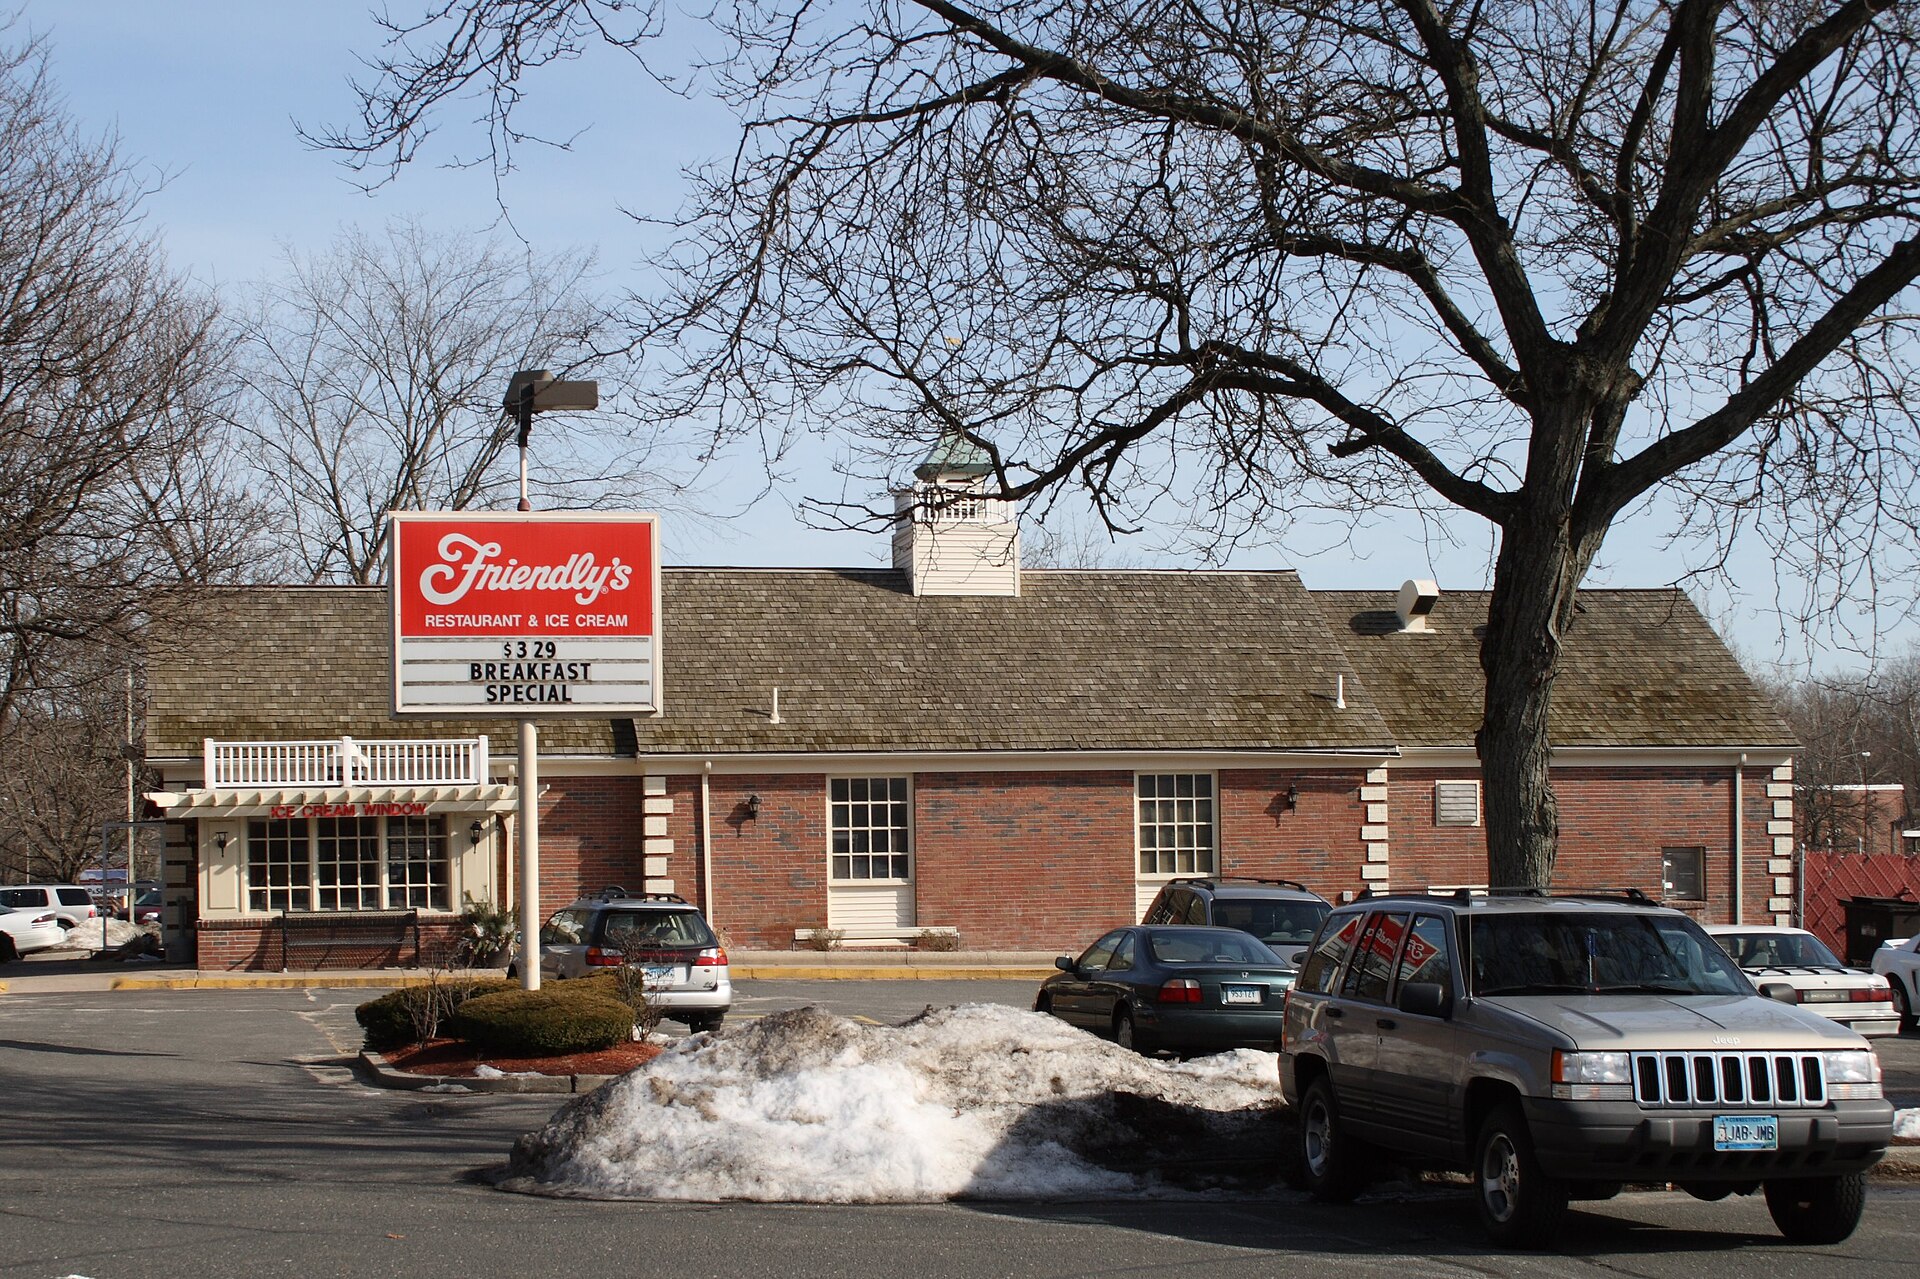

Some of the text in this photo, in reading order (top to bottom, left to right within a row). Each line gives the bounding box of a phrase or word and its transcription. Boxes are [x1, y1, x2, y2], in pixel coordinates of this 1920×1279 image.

[419, 532, 633, 605] Friendly's
[425, 614, 628, 627] RESTAURANT & ICE CREAM
[470, 663, 591, 680] BREAKFAST
[486, 684, 572, 701] SPECIAL
[270, 802, 427, 818] ICE CREAM WINDOW
[1712, 1034, 1741, 1046] Jeep
